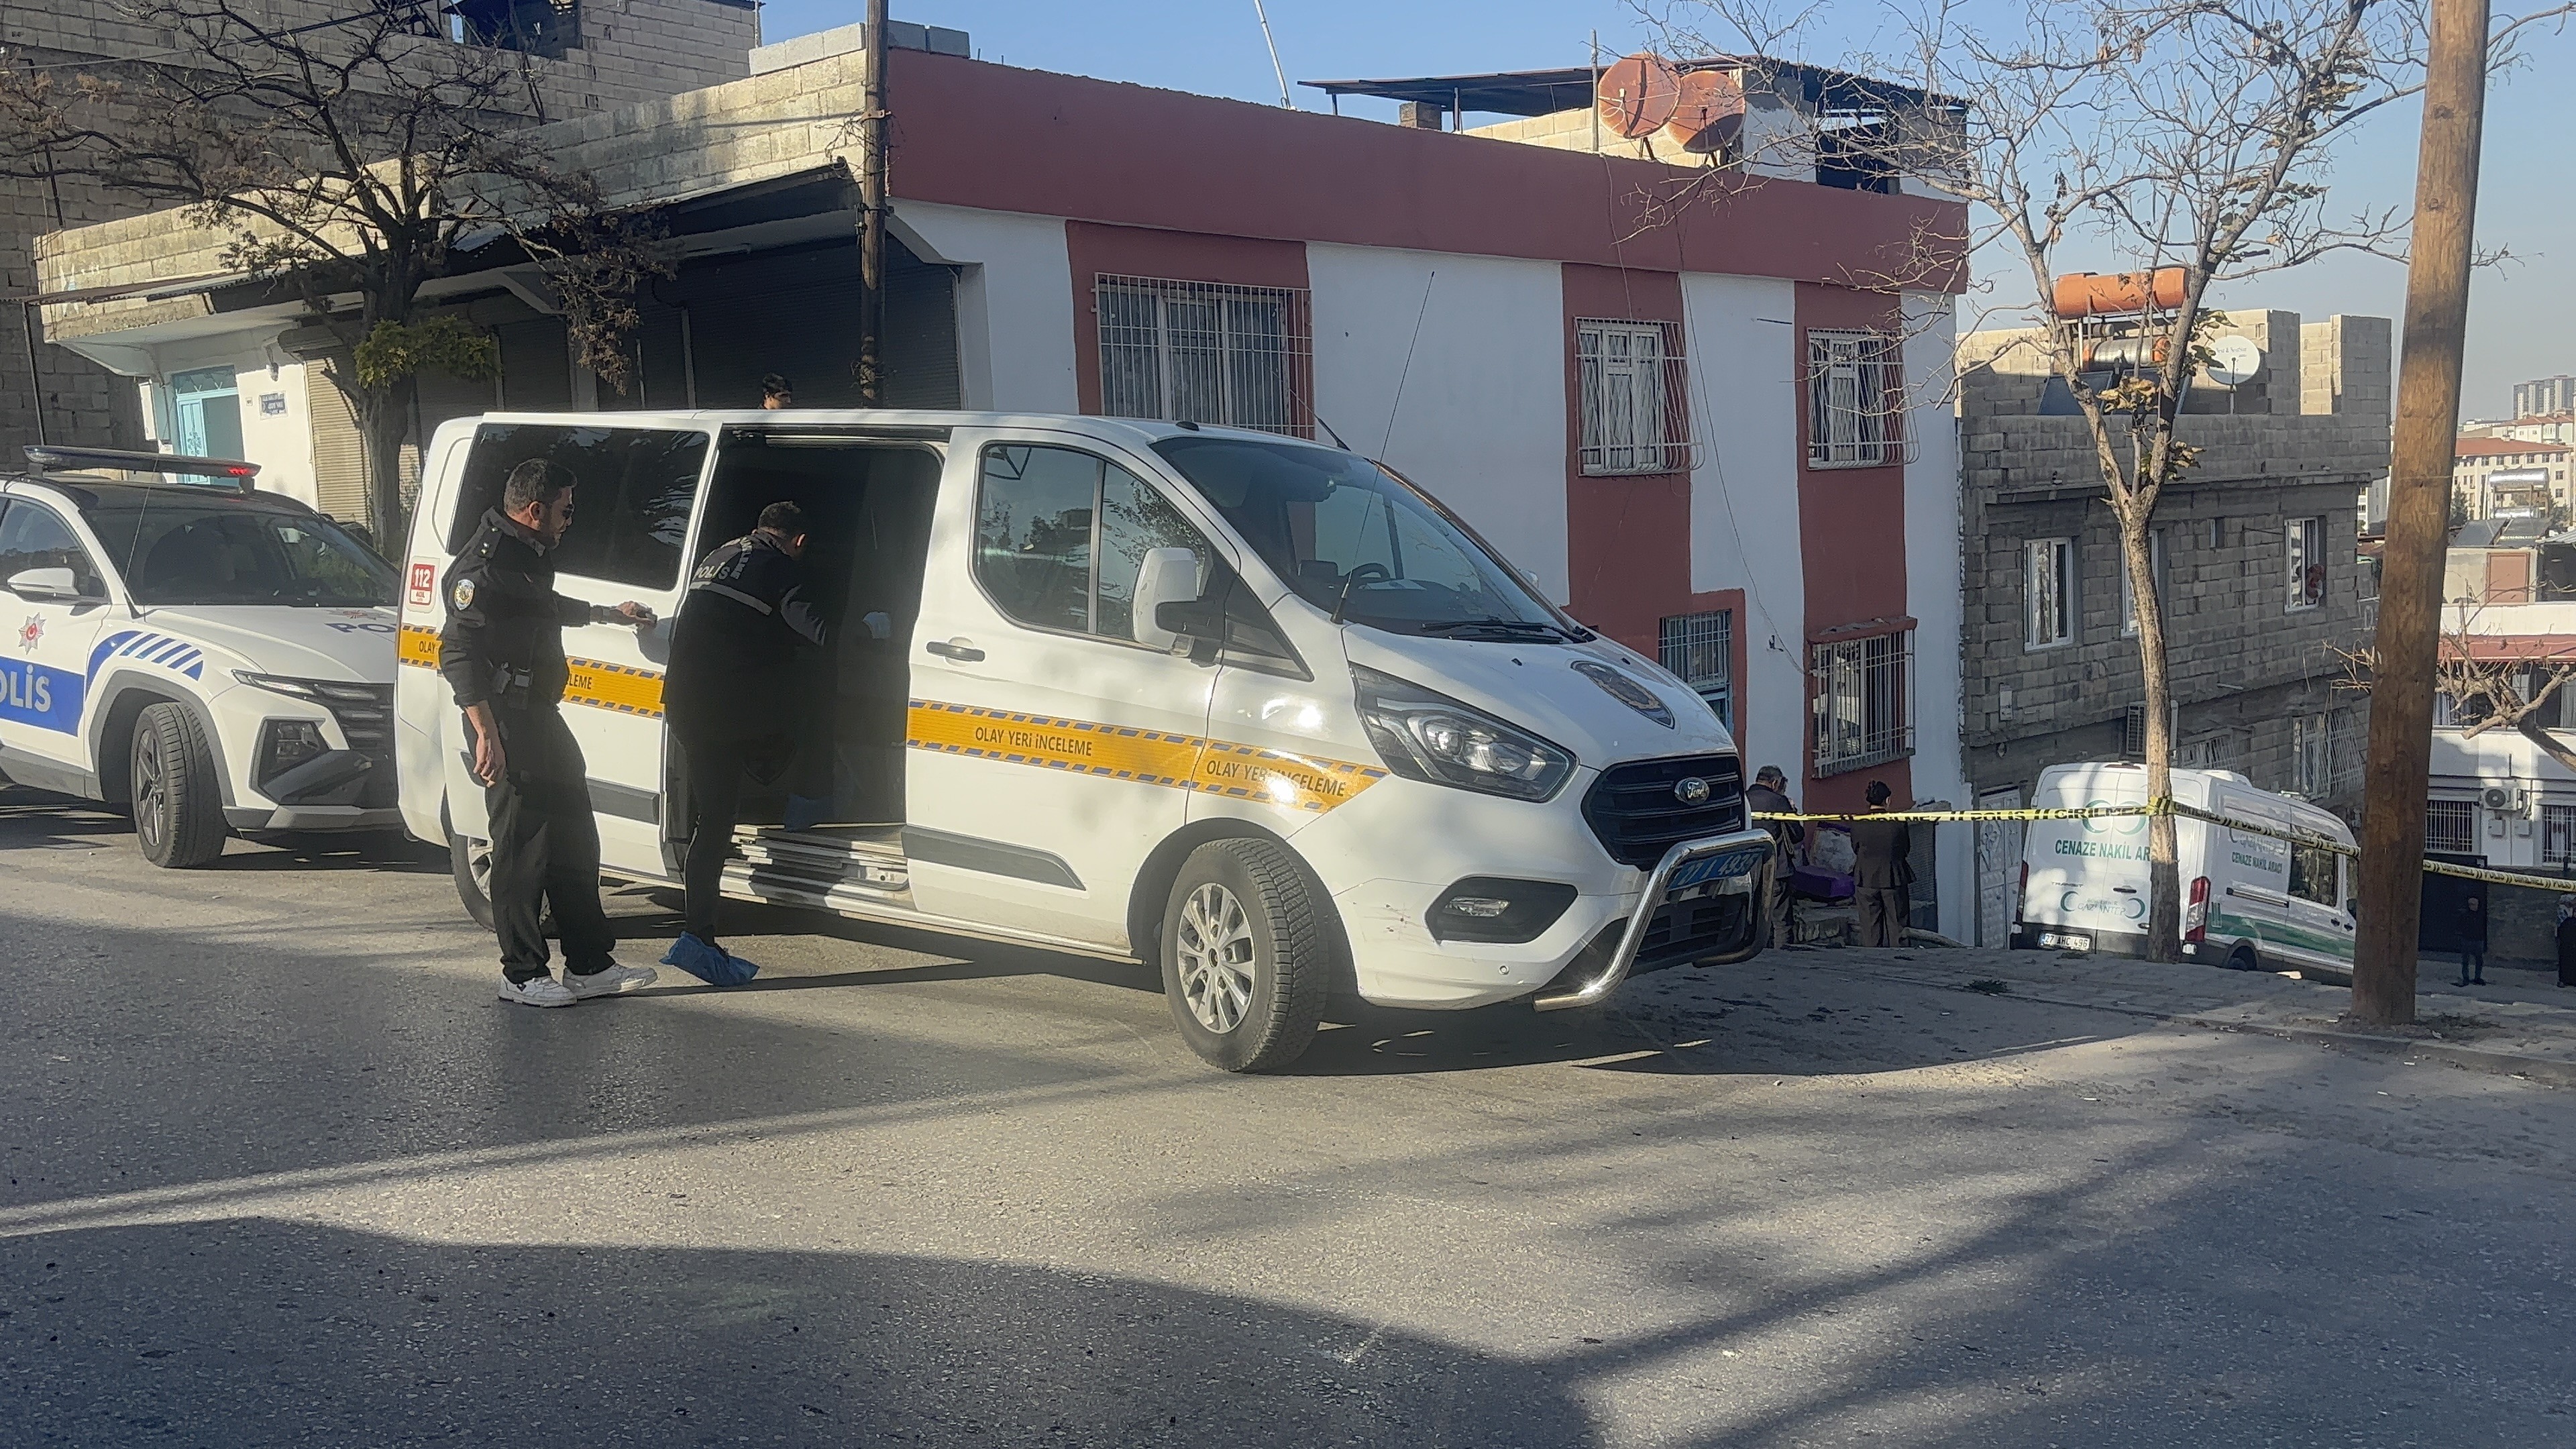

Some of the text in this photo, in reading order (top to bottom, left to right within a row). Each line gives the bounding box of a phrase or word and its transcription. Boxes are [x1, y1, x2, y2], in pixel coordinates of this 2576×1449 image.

[415, 568, 431, 588] 112
[324, 623, 396, 633] PO
[419, 641, 436, 654] OLAY
[569, 674, 592, 690] LEME
[975, 727, 1004, 744] OLAY
[1207, 760, 1240, 778] OLAY
[1244, 764, 1273, 781] YER
[1687, 782, 1705, 798] Ford
[2055, 839, 2151, 861] CENAZE NAKİL AR
[2045, 934, 2054, 943] 27
[2057, 936, 2071, 946] AHC
